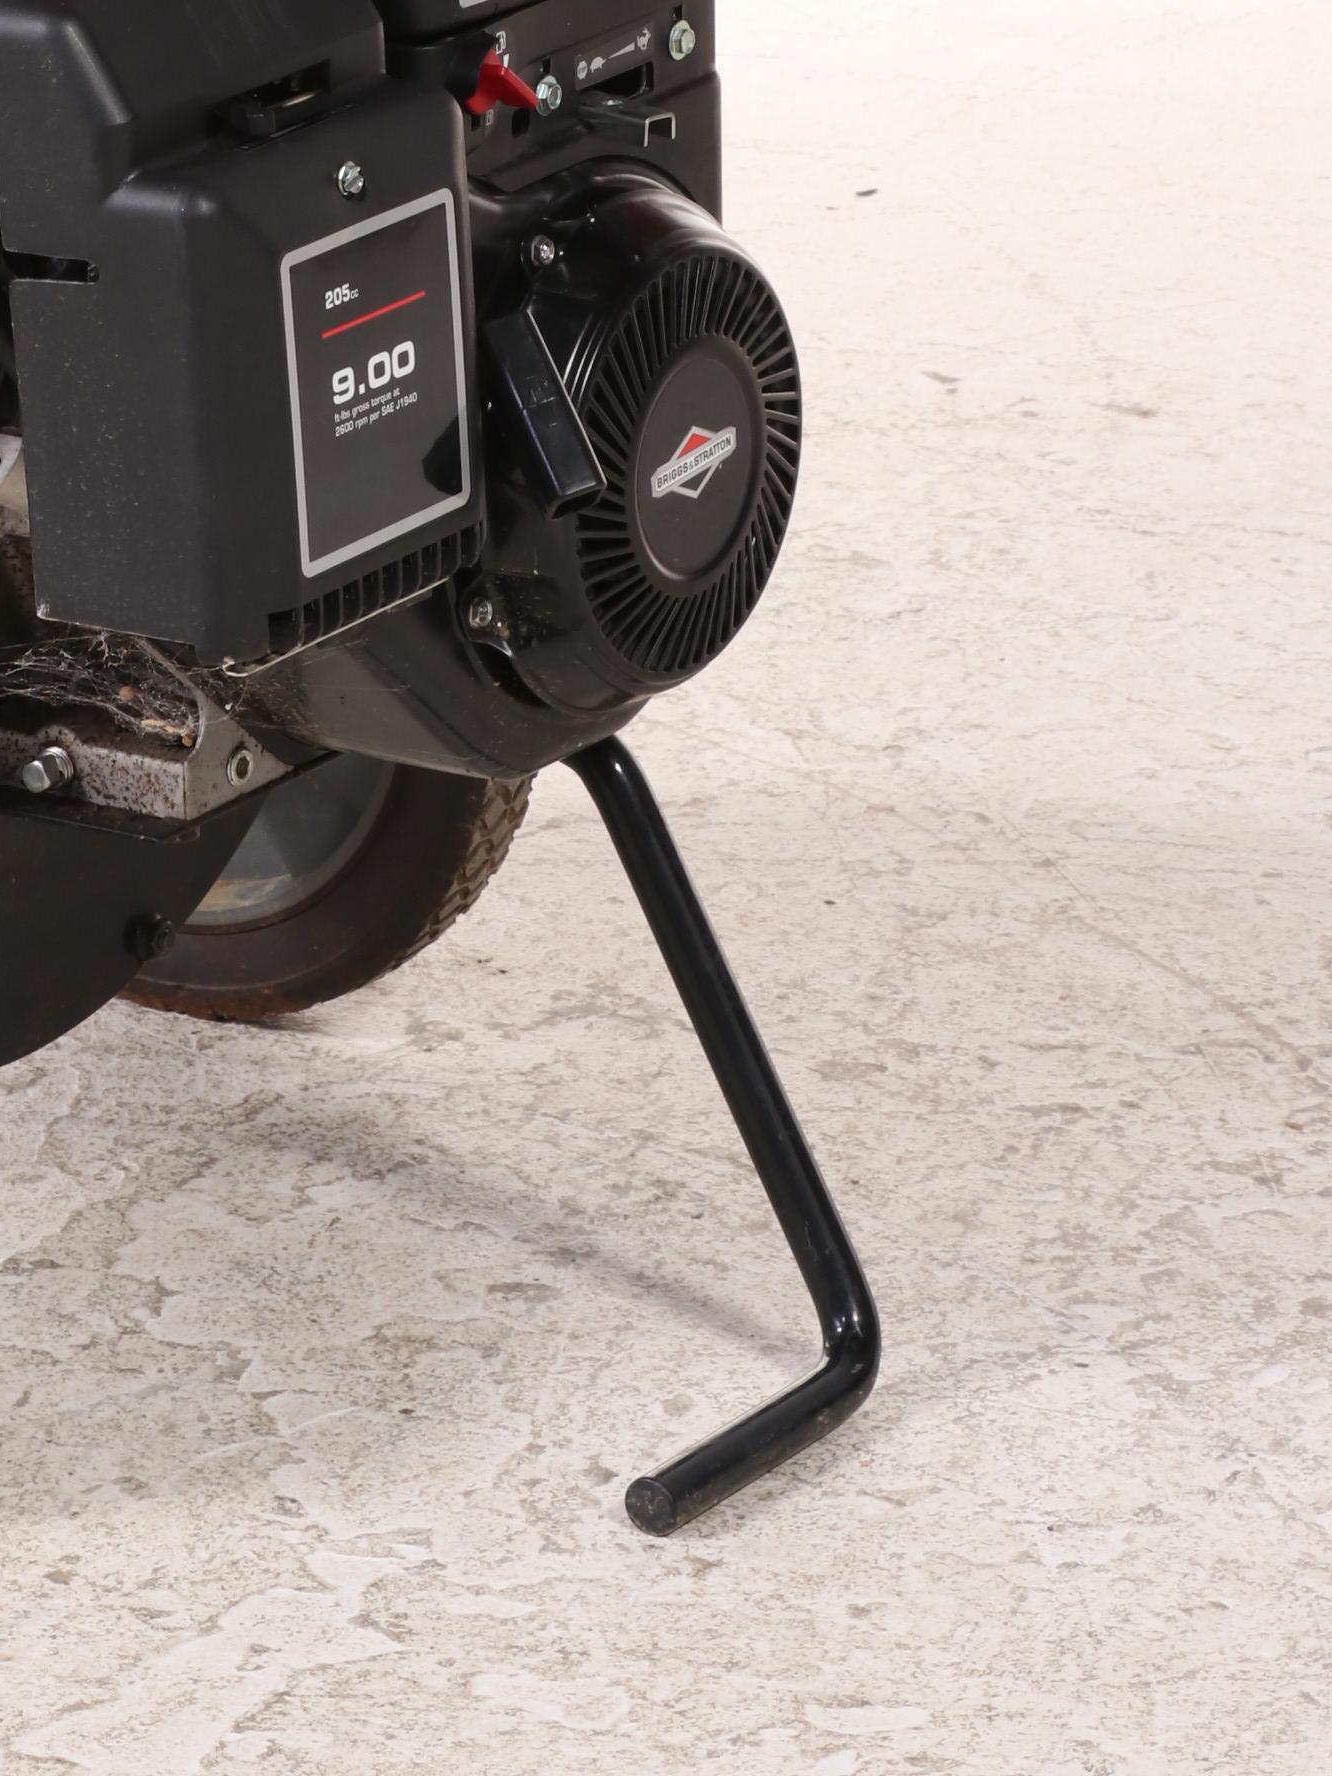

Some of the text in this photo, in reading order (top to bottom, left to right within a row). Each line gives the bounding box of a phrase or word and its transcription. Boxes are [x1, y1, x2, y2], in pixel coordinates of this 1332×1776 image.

[331, 340, 416, 405] 9.00
[351, 401, 370, 418] gross
[370, 391, 392, 408] torque
[354, 415, 369, 430] rpm
[369, 409, 381, 425] per
[381, 402, 395, 417] SAE
[395, 391, 418, 411] J1940
